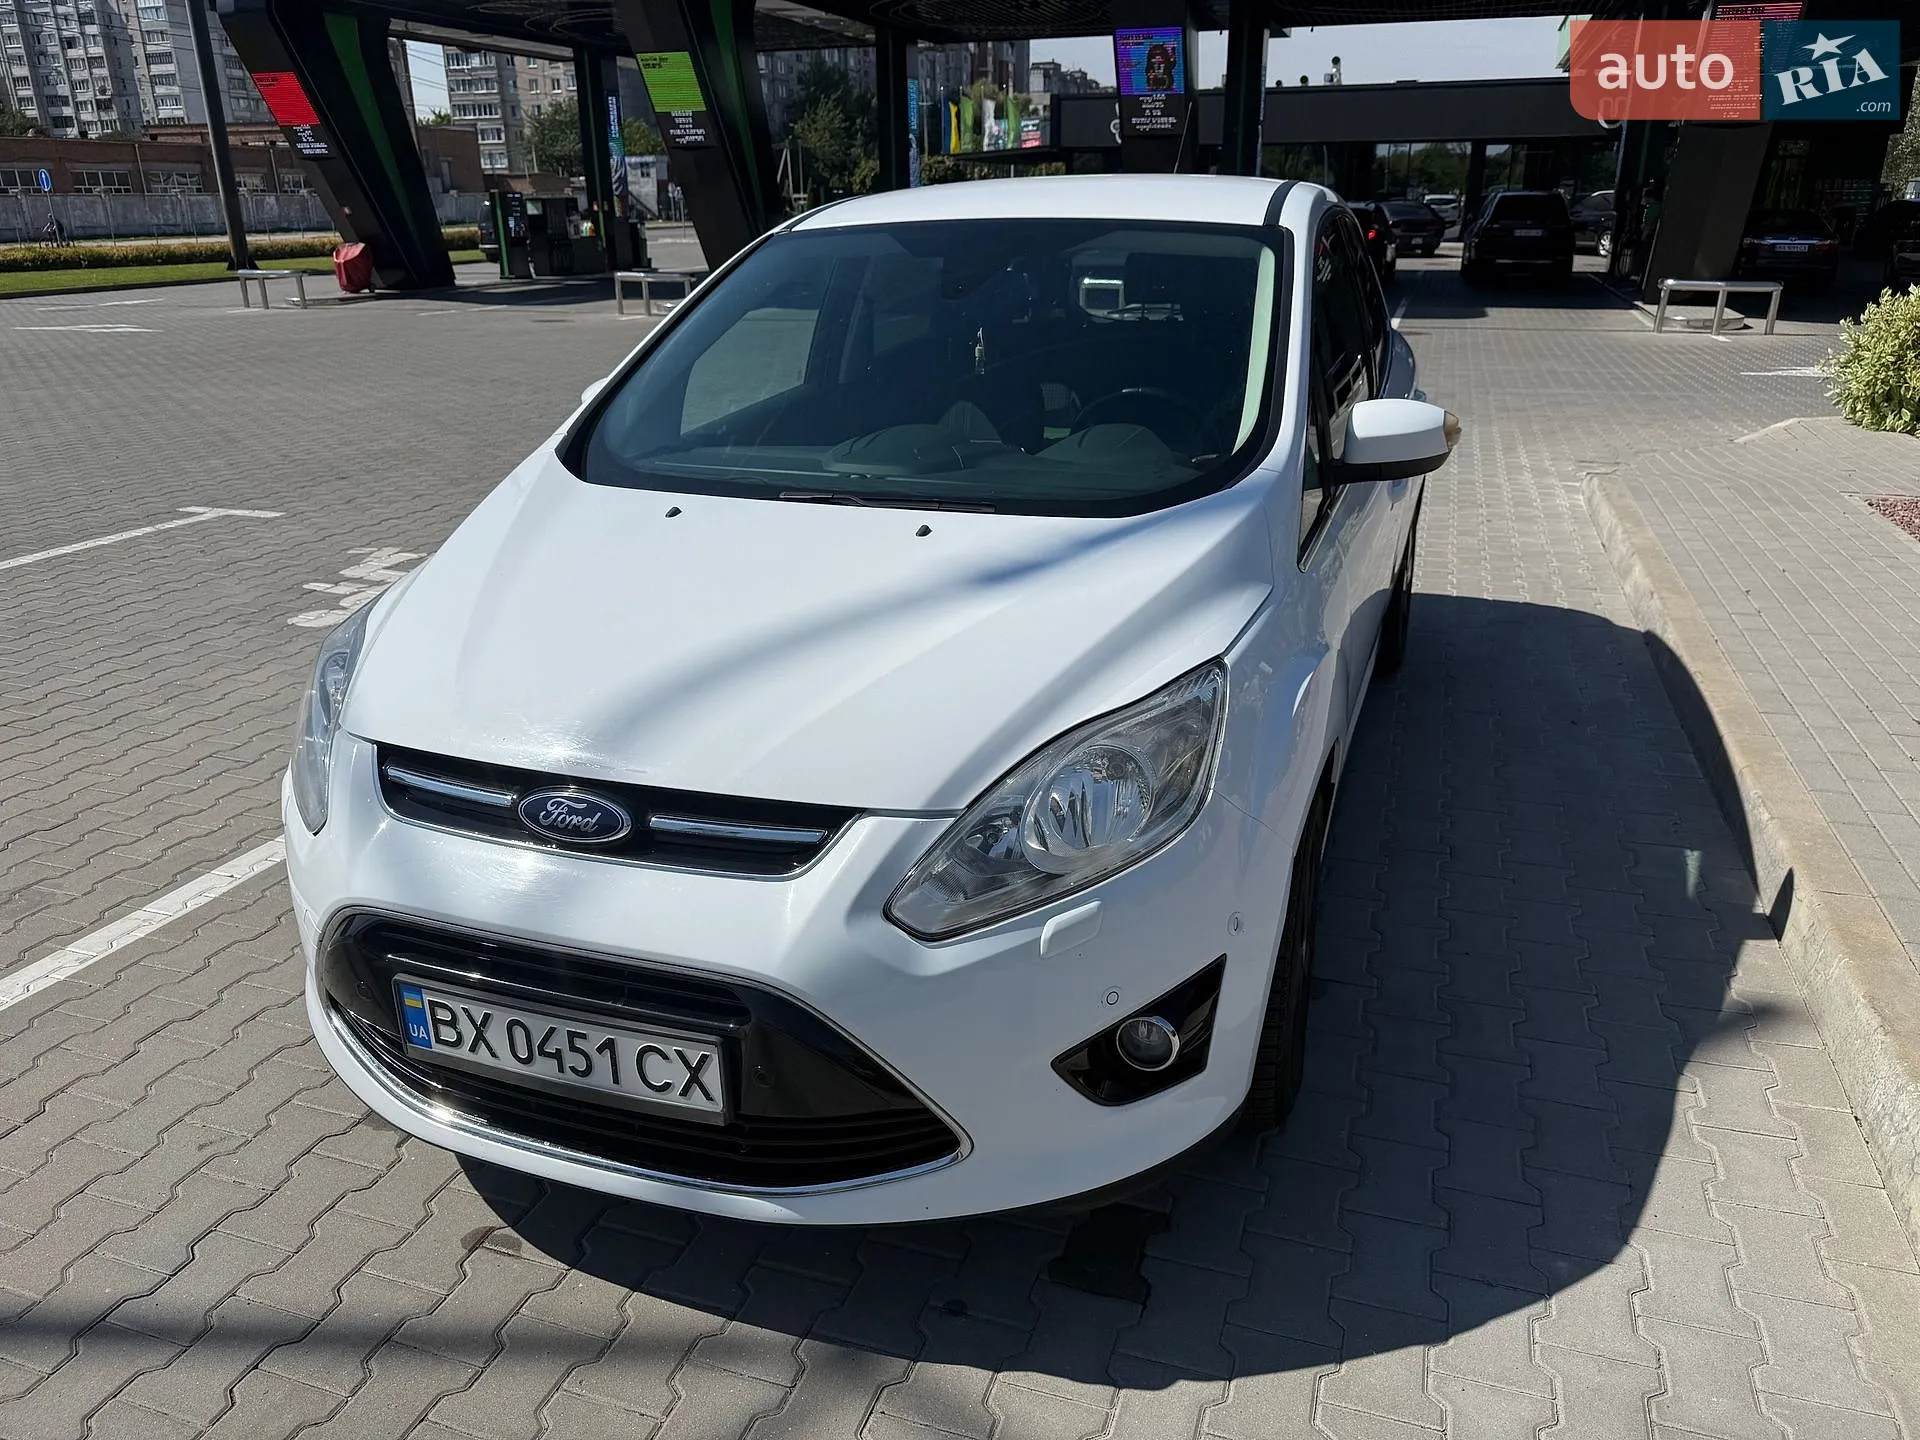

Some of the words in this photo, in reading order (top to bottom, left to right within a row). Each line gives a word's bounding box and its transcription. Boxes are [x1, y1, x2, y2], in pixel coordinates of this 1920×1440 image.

[539, 798, 601, 832] Ford
[409, 1022, 428, 1040] UA
[428, 998, 499, 1059] BX
[506, 1018, 621, 1085] 0451
[635, 1043, 714, 1102] CX
